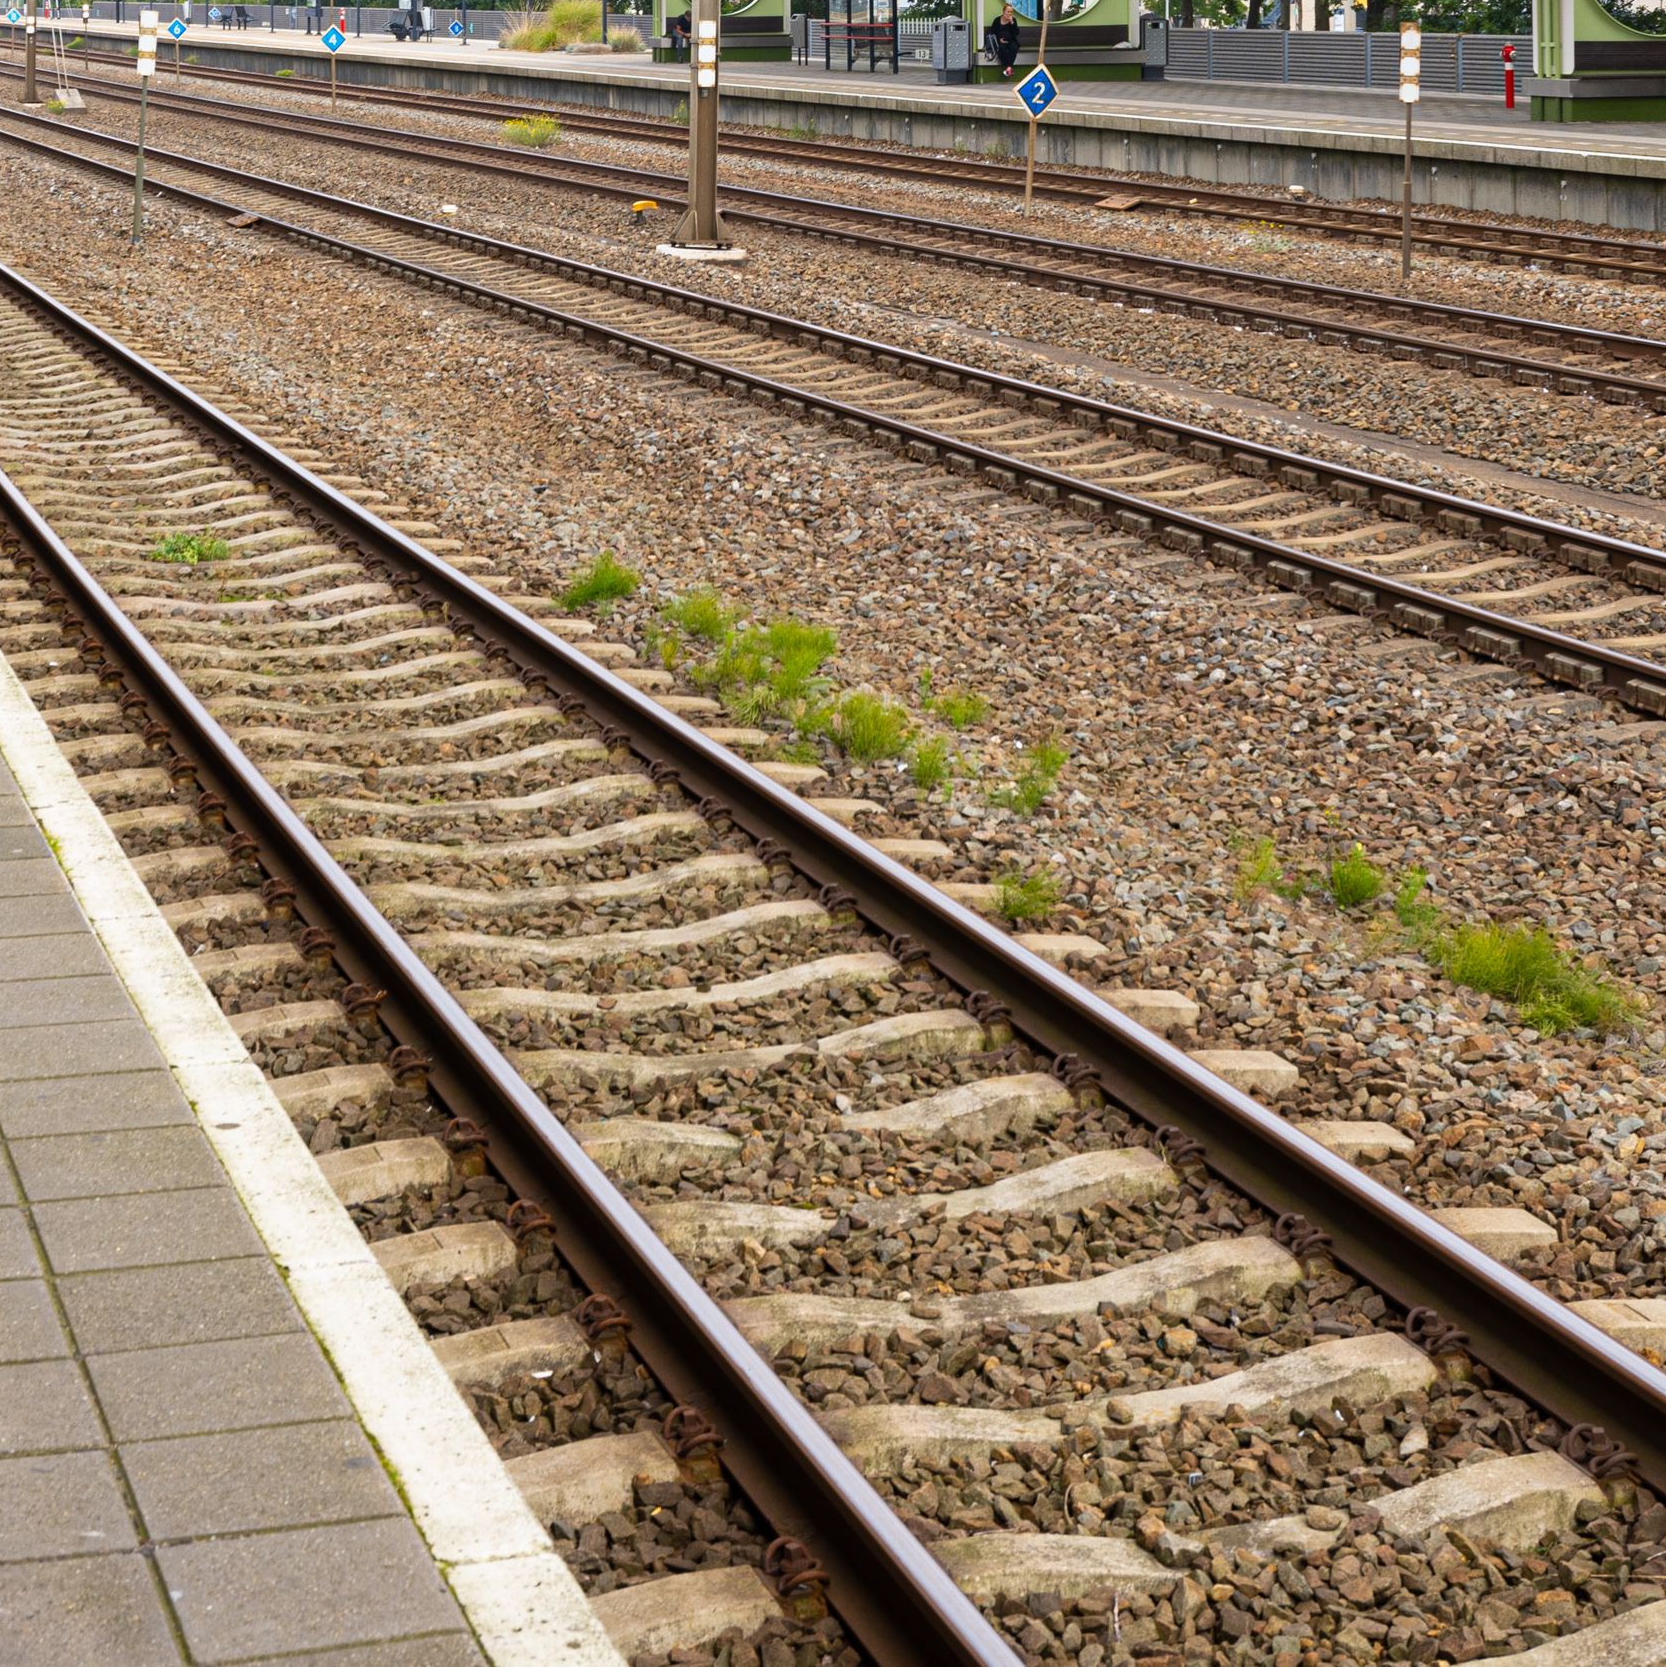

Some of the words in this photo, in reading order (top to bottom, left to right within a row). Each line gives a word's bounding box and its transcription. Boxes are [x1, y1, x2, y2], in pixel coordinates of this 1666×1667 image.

[173, 25, 180, 34] 6
[328, 34, 337, 45] 4
[1032, 82, 1045, 104] 2
